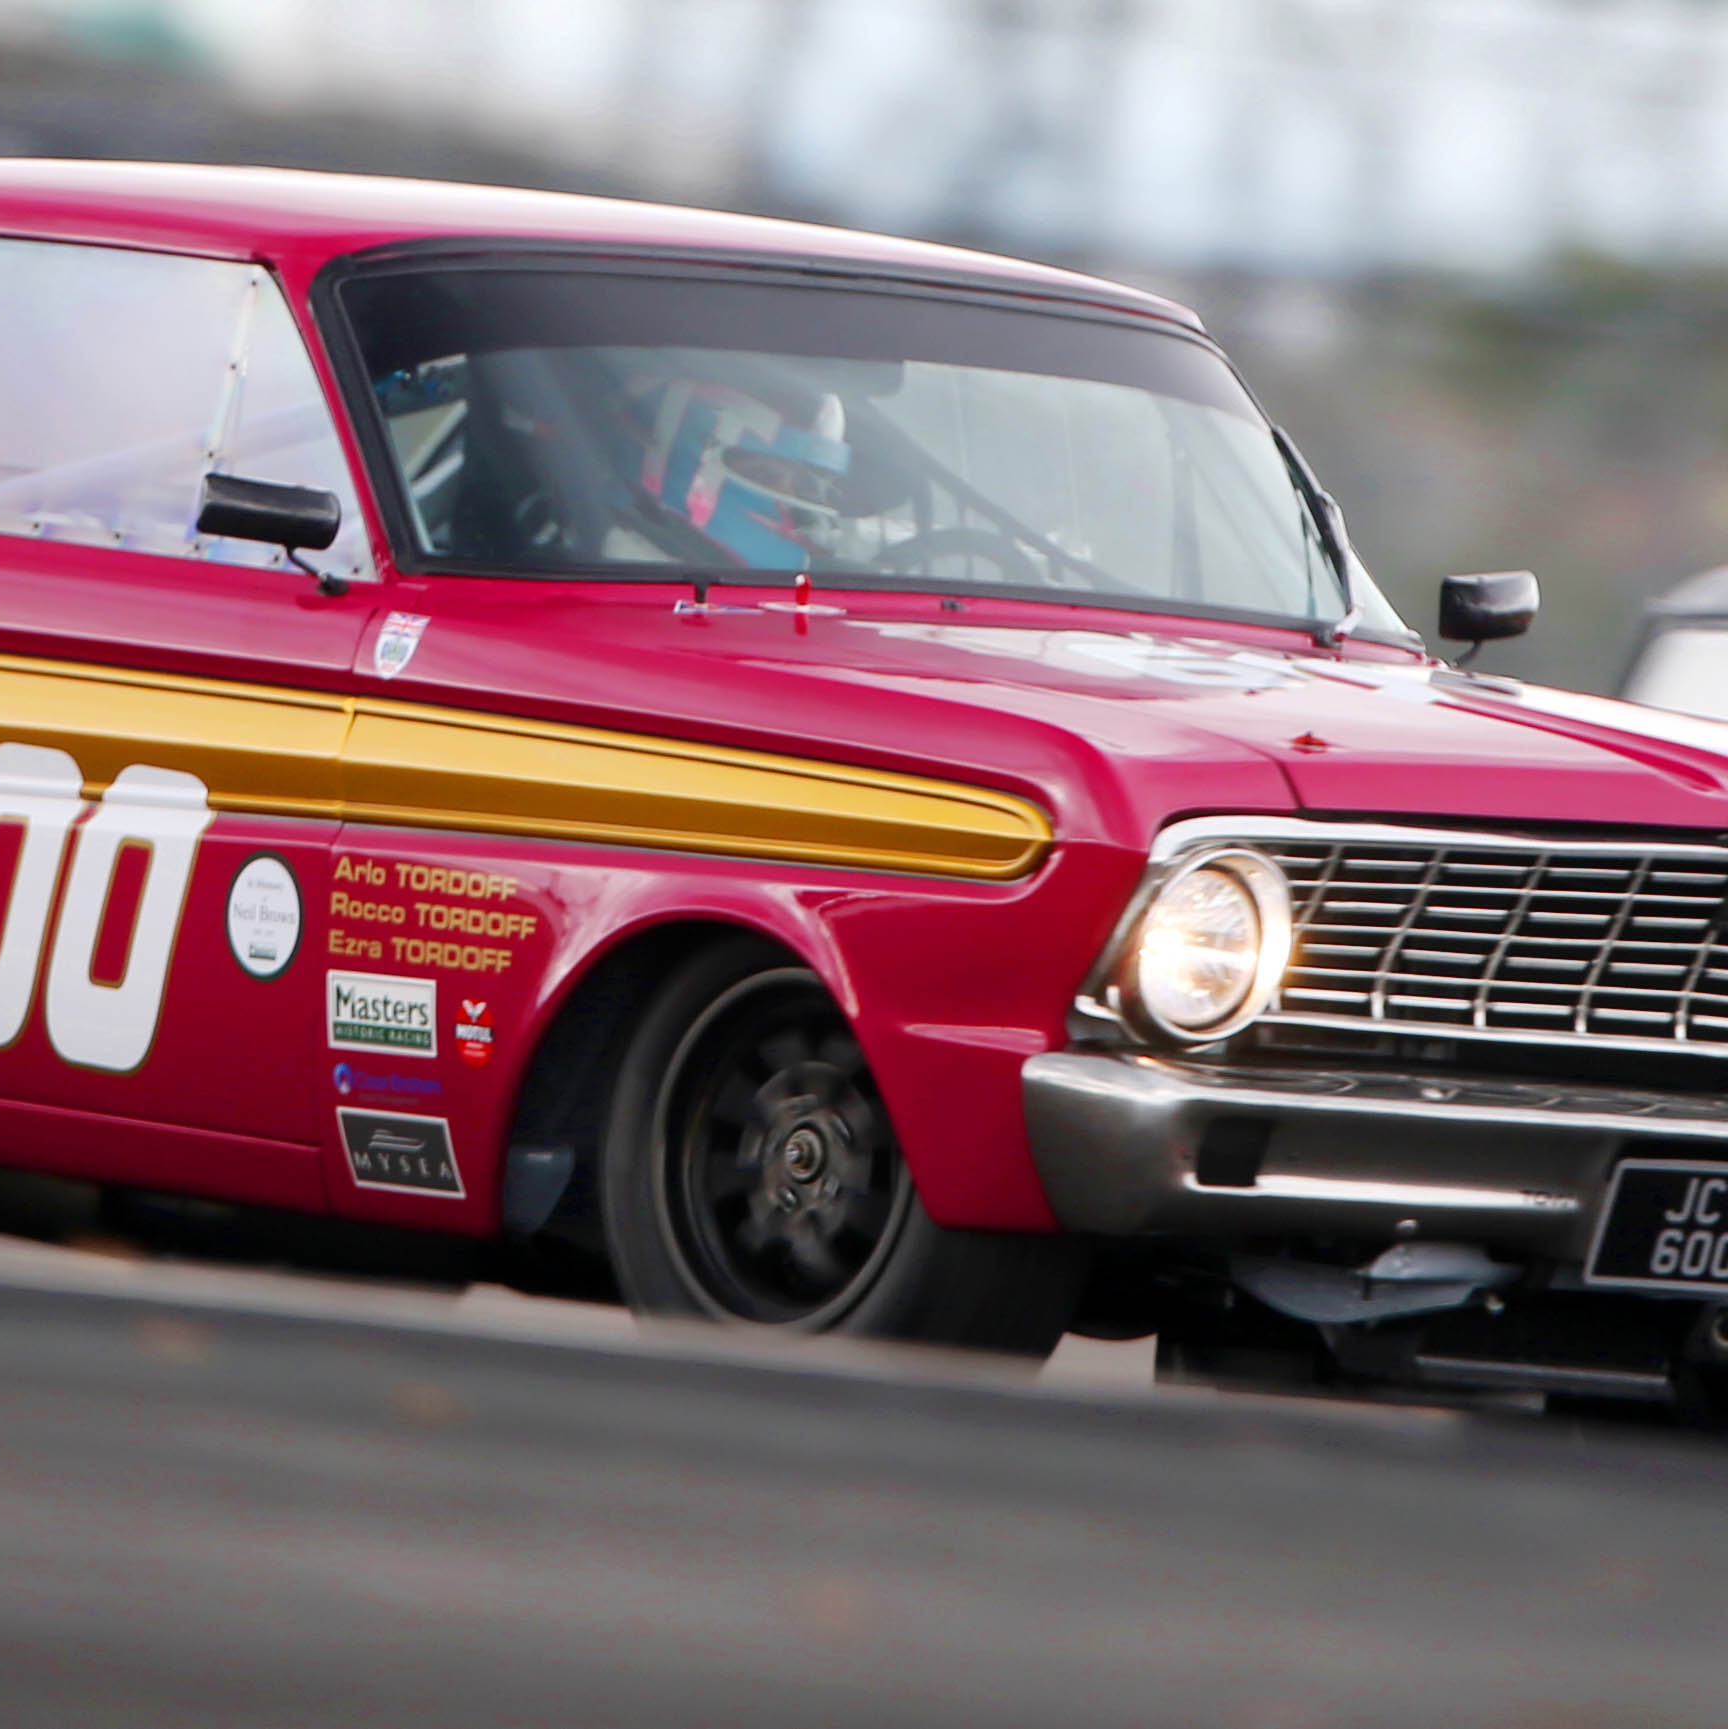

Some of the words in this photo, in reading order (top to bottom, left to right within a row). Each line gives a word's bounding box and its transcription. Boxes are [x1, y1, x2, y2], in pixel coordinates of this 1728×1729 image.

[334, 856, 387, 886] Arlo
[395, 863, 519, 901] TORDOFF
[330, 891, 406, 924] Rocco
[414, 902, 538, 940] TORDOFF
[328, 929, 383, 959] Ezra
[390, 936, 512, 974] TORDOFF
[336, 984, 429, 1026] Masters
[354, 1151, 453, 1180] MYSEA
